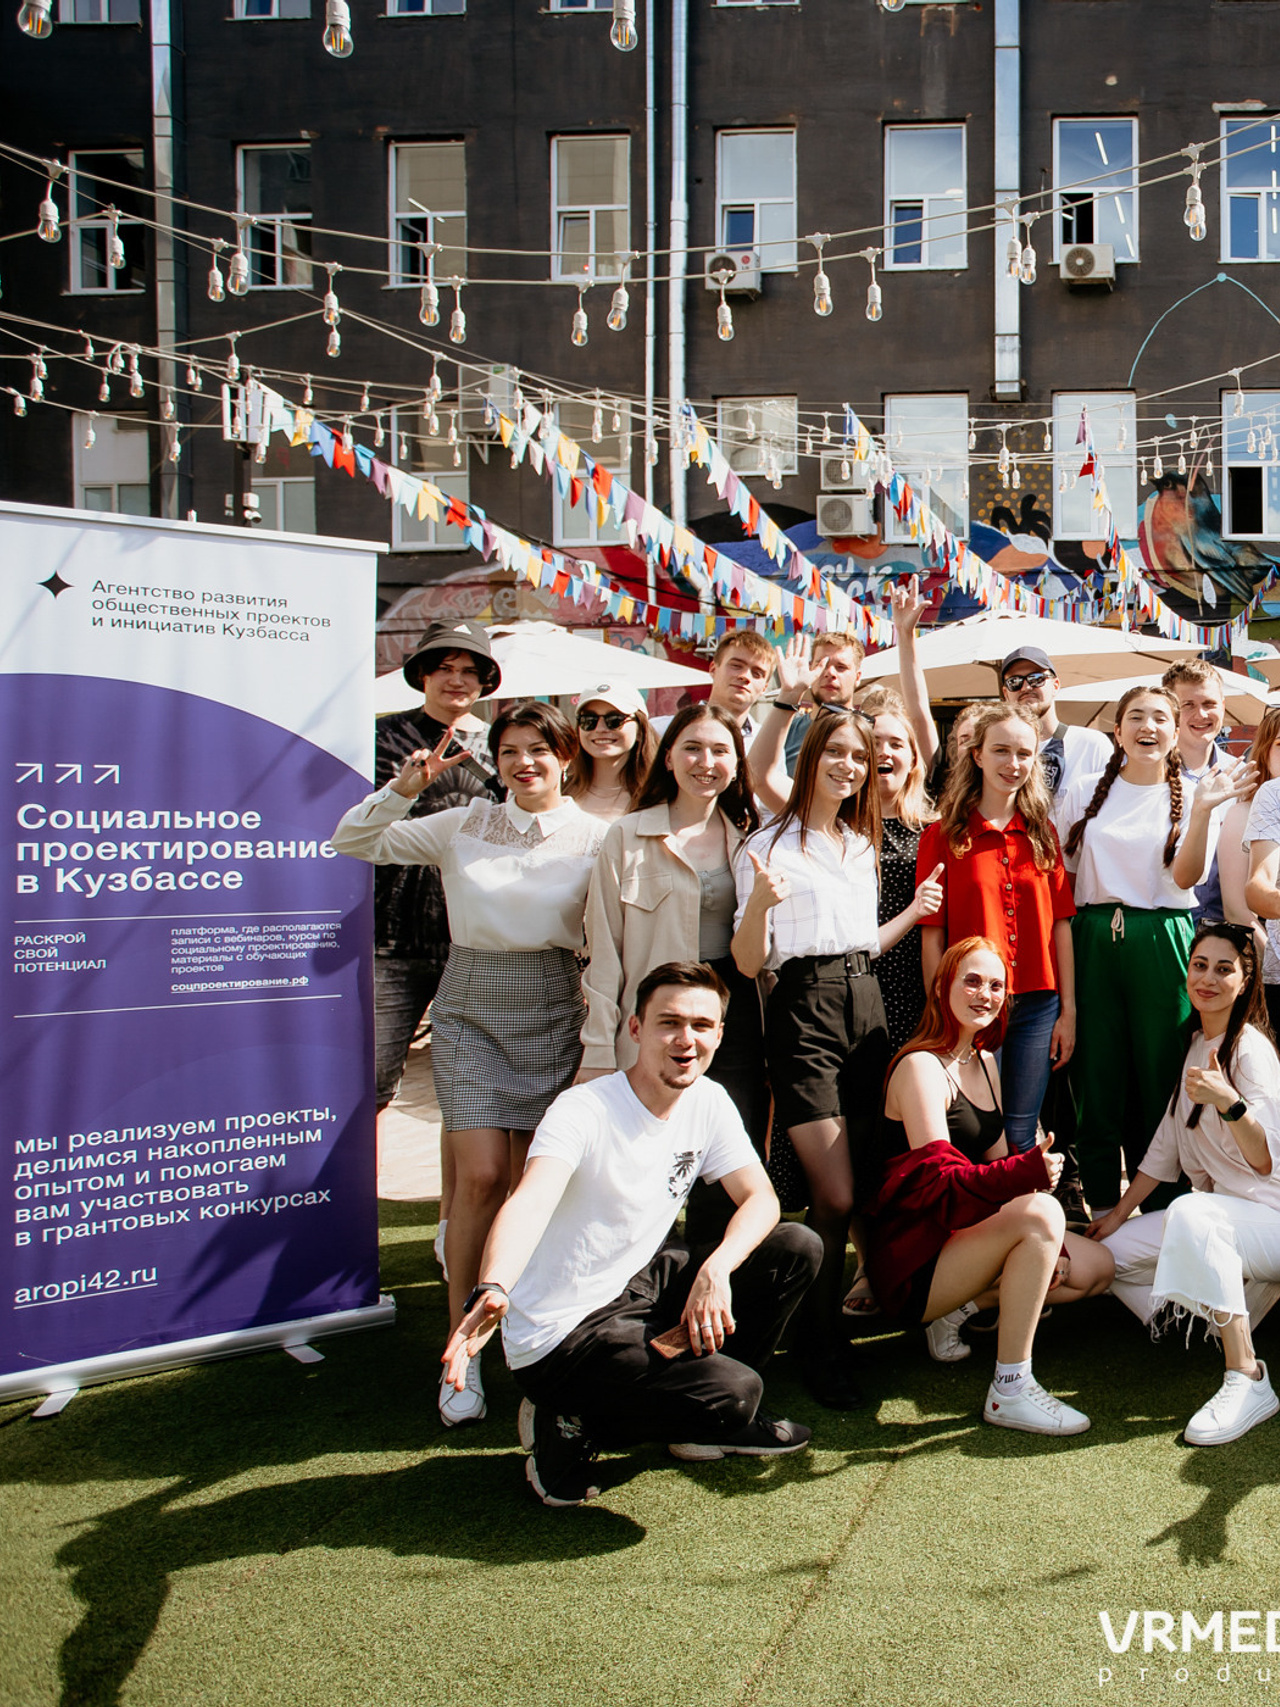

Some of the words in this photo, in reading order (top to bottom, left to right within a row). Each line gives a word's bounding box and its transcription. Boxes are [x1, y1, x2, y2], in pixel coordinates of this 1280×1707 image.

[92, 580, 196, 601] Агентство
[201, 591, 288, 608] развития
[92, 597, 240, 621] общественных
[246, 611, 331, 628] проектов
[92, 617, 103, 627] и
[111, 618, 216, 635] инициатив
[223, 623, 310, 642] Кузбасса
[17, 803, 261, 833] Социальное
[17, 837, 338, 867] проектирование
[17, 872, 39, 894] в
[56, 867, 244, 898] Кузбассе
[14, 931, 86, 945] РАСКРОЙ
[171, 926, 238, 937] платформа,
[242, 925, 260, 934] где
[262, 922, 342, 933] располагаются
[171, 937, 211, 946] записи
[224, 933, 286, 943] вебинаров,
[288, 932, 320, 942] курсы
[323, 931, 336, 940] по
[14, 946, 59, 960] СВОЙ
[171, 944, 245, 956] социальному
[171, 955, 233, 966] материалы
[236, 954, 243, 962] с
[246, 951, 308, 963] обучающих
[14, 959, 107, 973] ПОТЕНЦИАЛ
[171, 964, 225, 975] проектов
[171, 976, 309, 992] соцпроектирование.рф
[15, 1137, 57, 1154] мы
[69, 1117, 216, 1152] реализуем
[225, 1106, 338, 1136] проекты,
[14, 1149, 137, 1181] делимся
[147, 1128, 323, 1162] накопленным
[15, 1173, 125, 1204] опытом
[134, 1170, 151, 1185] и
[160, 1152, 286, 1182] помогаем
[15, 1202, 71, 1224] вам
[80, 1179, 249, 1219] участвовать
[15, 1230, 31, 1246] в
[42, 1207, 190, 1244] грантовых
[199, 1187, 332, 1220] конкурсах
[14, 1267, 158, 1306] aropi42.ru
